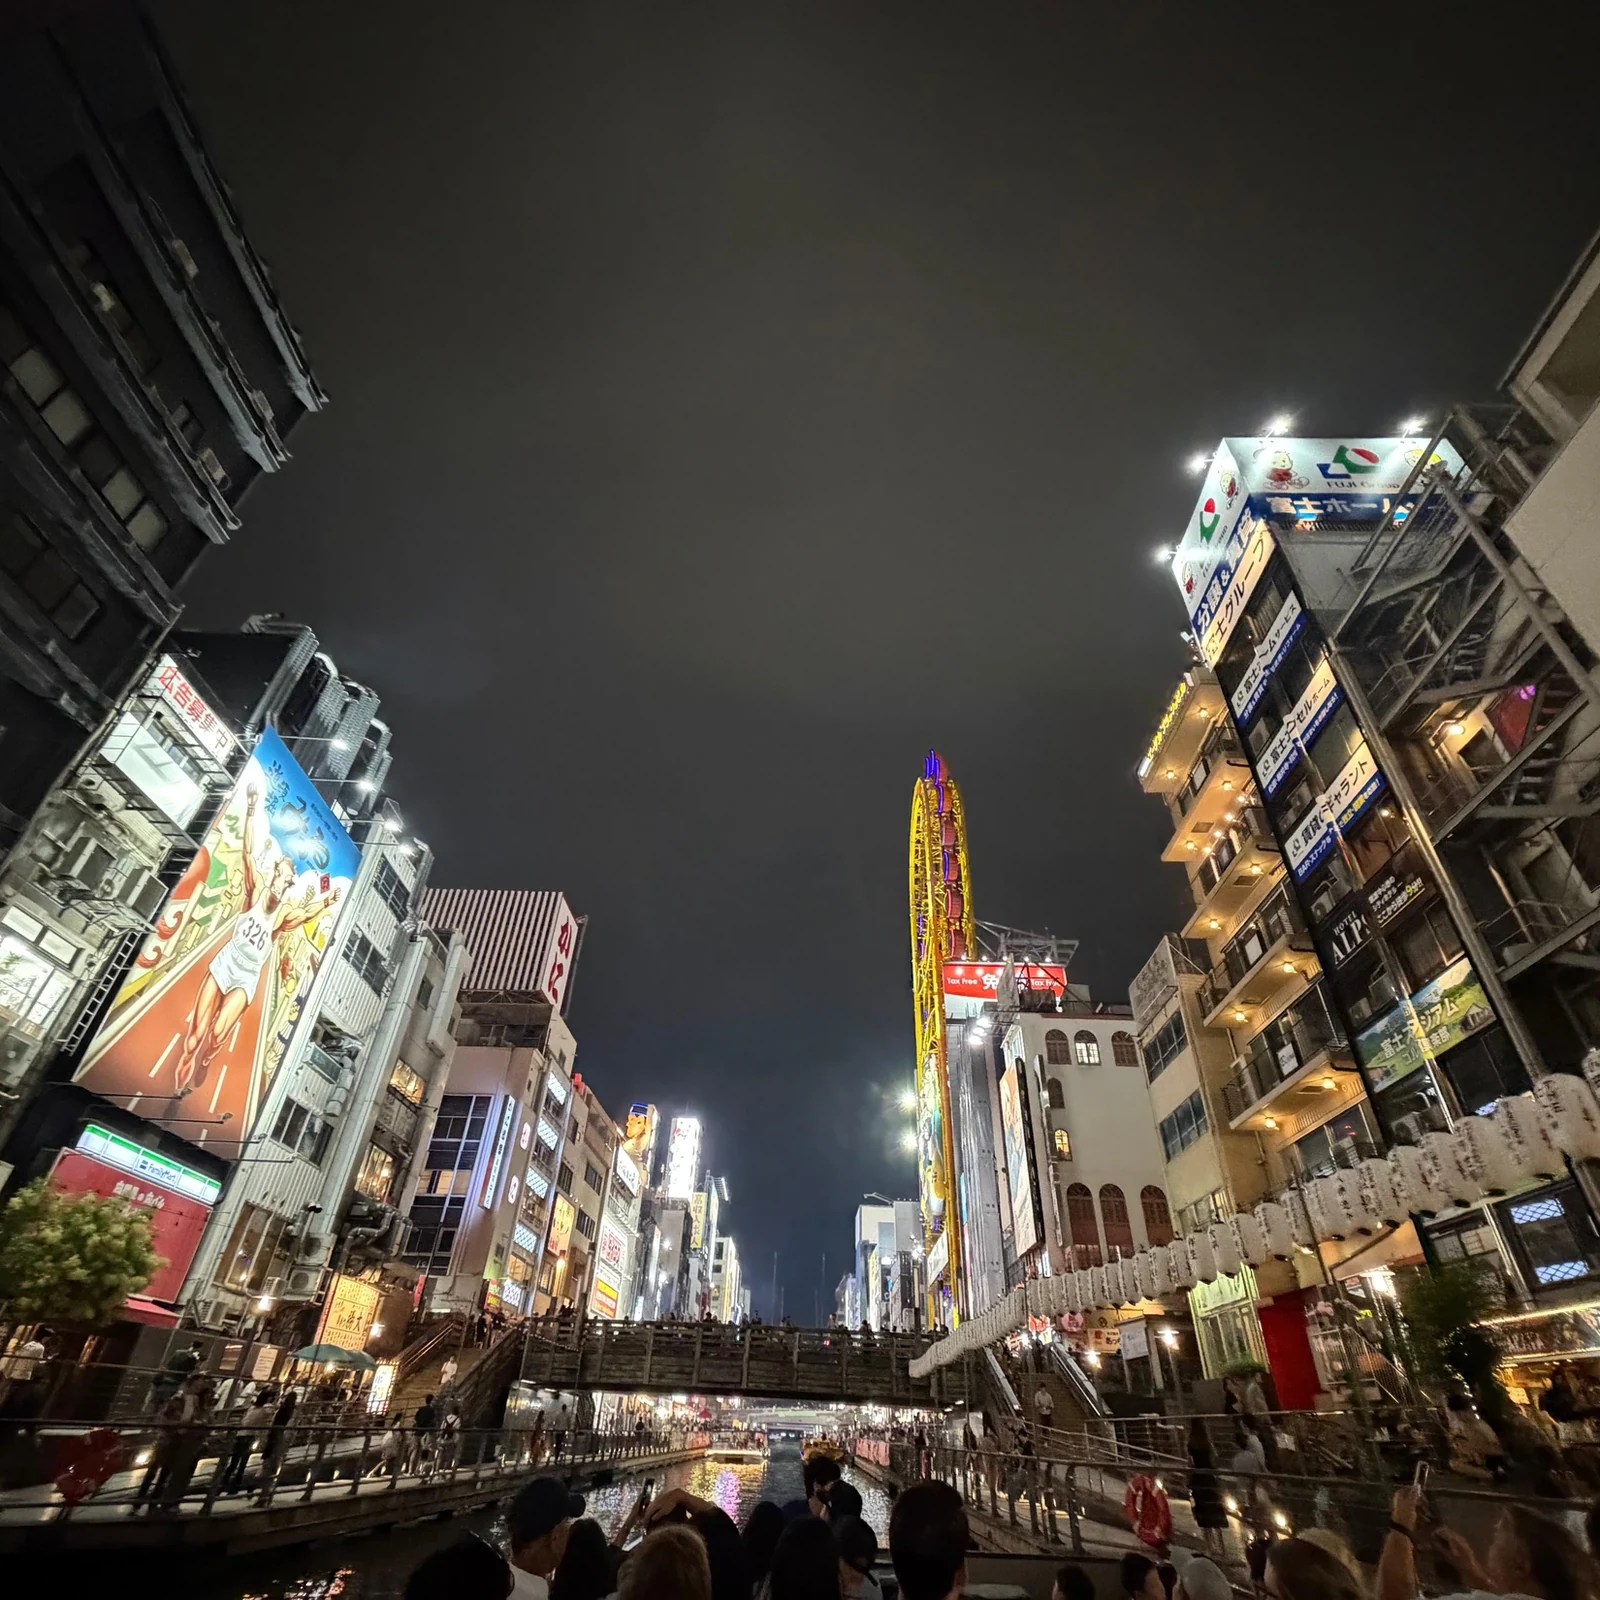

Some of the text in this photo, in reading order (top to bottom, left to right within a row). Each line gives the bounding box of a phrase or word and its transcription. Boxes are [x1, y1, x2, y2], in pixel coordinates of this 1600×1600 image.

[1326, 480, 1357, 489] FUJI
[157, 665, 230, 750] 広告募集中
[242, 915, 270, 950] 326
[1333, 910, 1357, 935] HOTEL
[947, 977, 960, 985] Tax
[148, 1161, 177, 1184] FamilyMart
